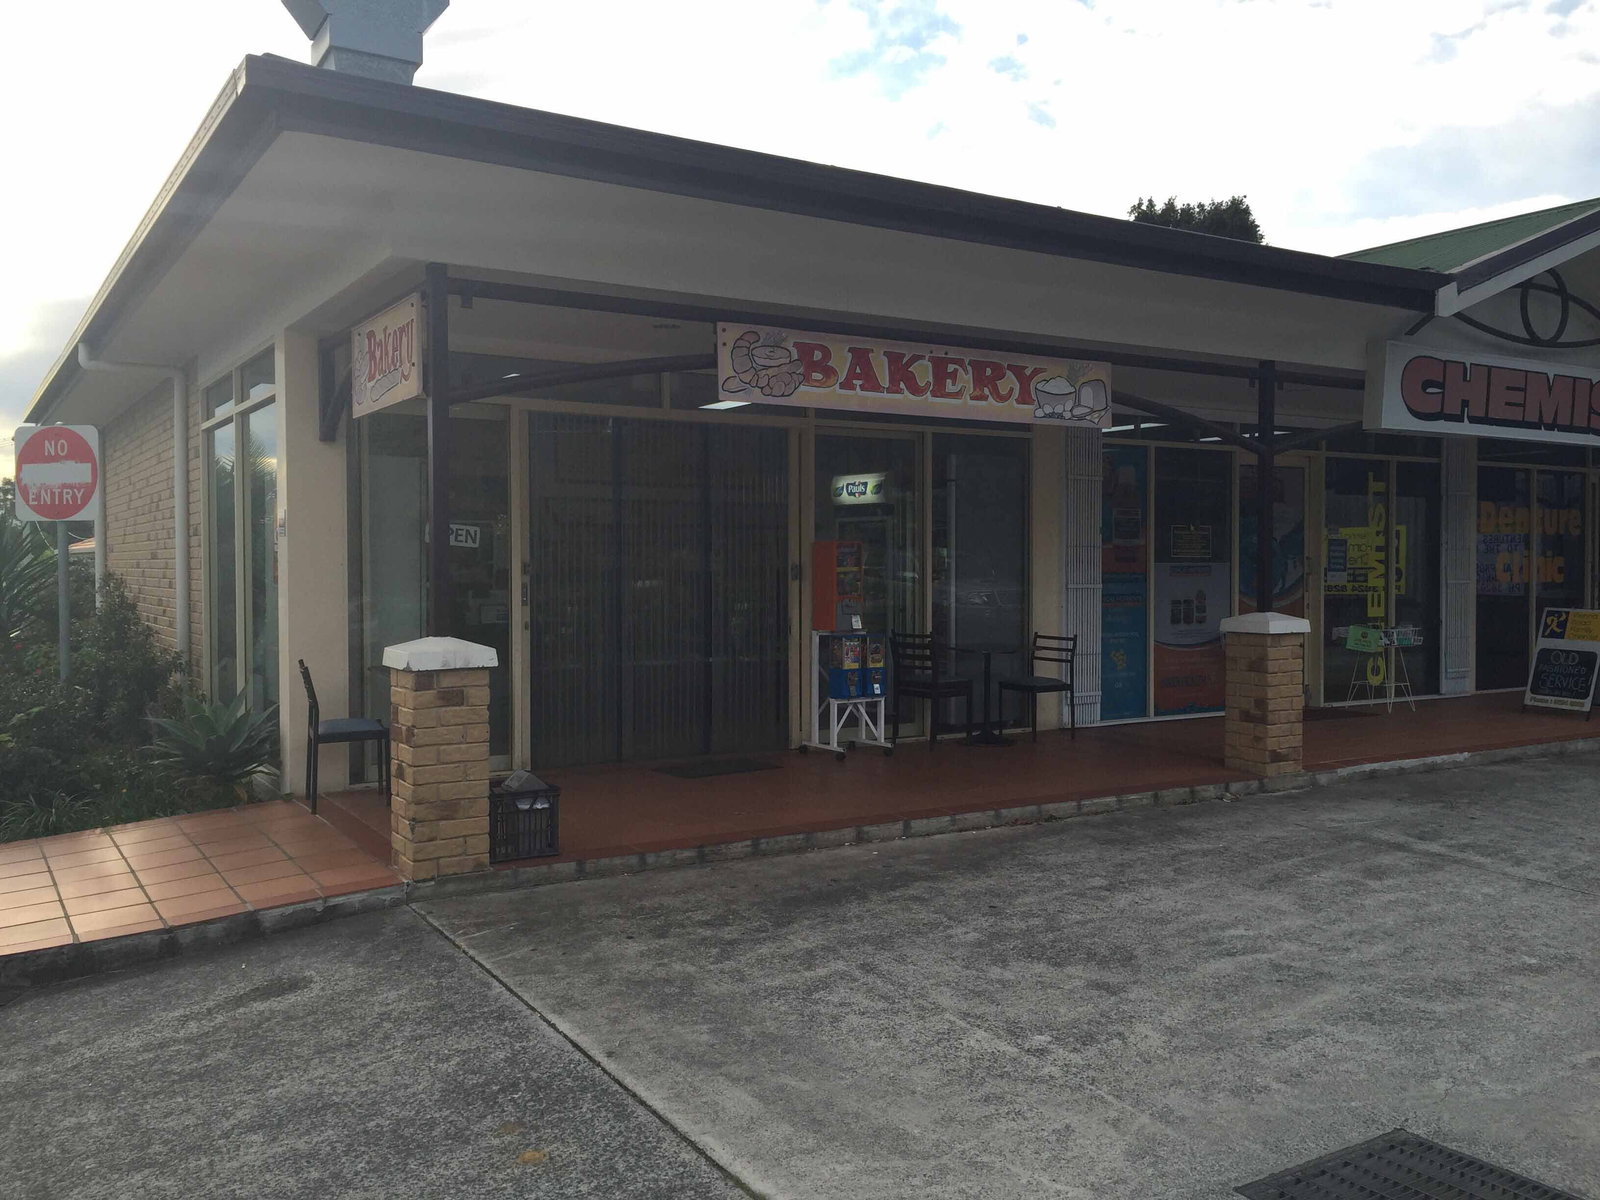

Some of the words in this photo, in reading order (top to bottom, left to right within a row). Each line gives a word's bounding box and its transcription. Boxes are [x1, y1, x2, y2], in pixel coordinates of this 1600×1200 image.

[366, 318, 414, 383] Bakery
[791, 341, 1048, 407] BAKERY
[1401, 355, 1600, 437] CHEMI
[44, 439, 68, 456] NO
[28, 488, 85, 505] ENTRY
[848, 484, 866, 494] Pauls
[1367, 472, 1387, 686] CEMIST
[1495, 551, 1566, 583] Clinic
[1550, 650, 1579, 665] OLD
